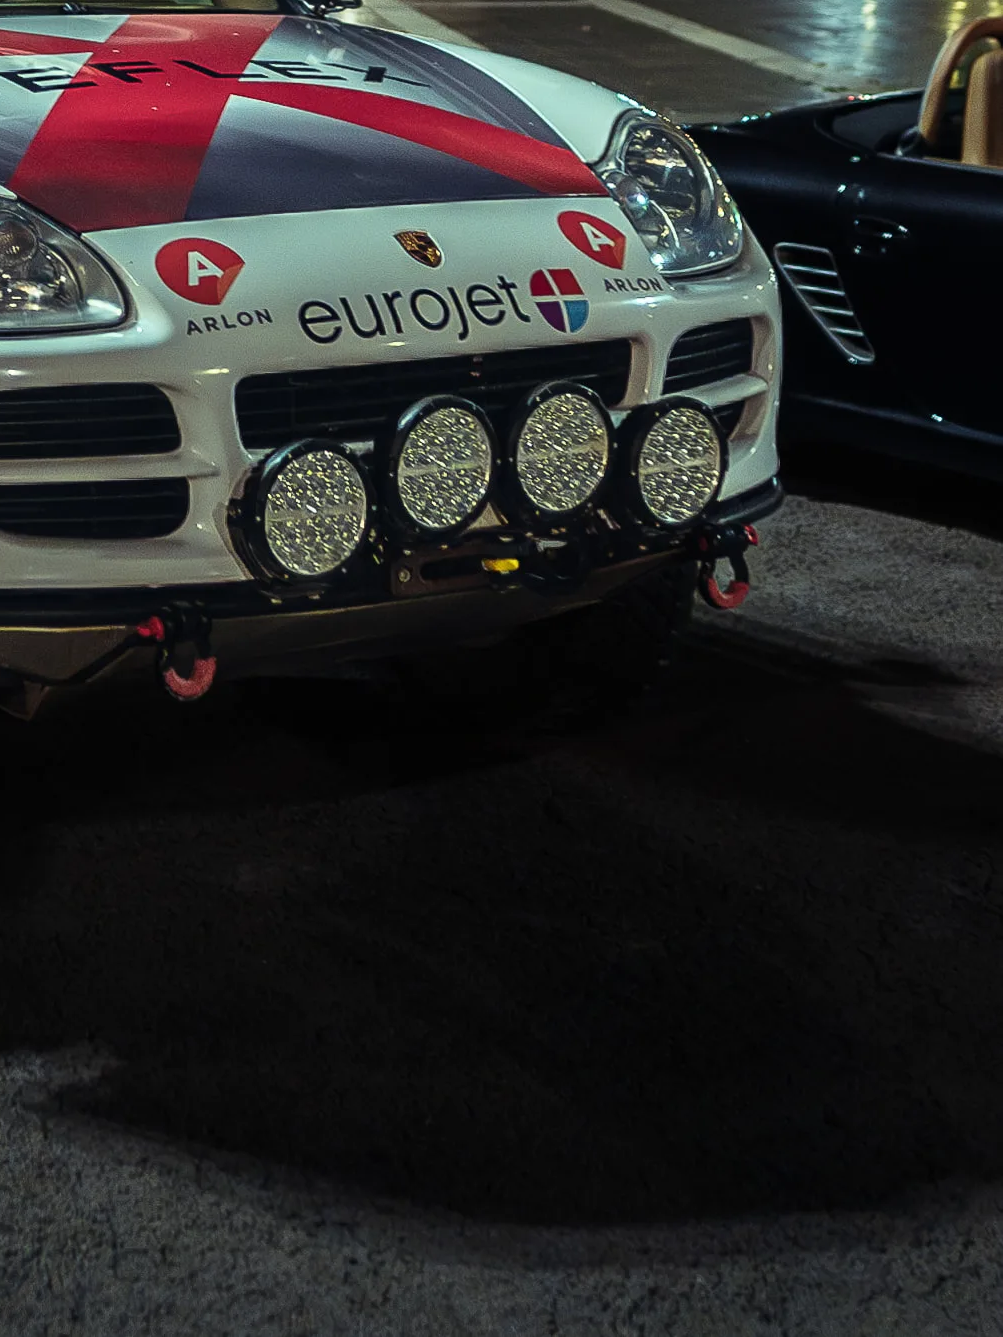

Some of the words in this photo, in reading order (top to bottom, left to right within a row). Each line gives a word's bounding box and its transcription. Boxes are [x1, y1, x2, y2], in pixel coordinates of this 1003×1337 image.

[579, 222, 615, 252] A
[188, 251, 224, 286] A
[604, 278, 663, 292] ARLON
[187, 308, 273, 336] ARLON
[298, 274, 531, 345] eurojet
